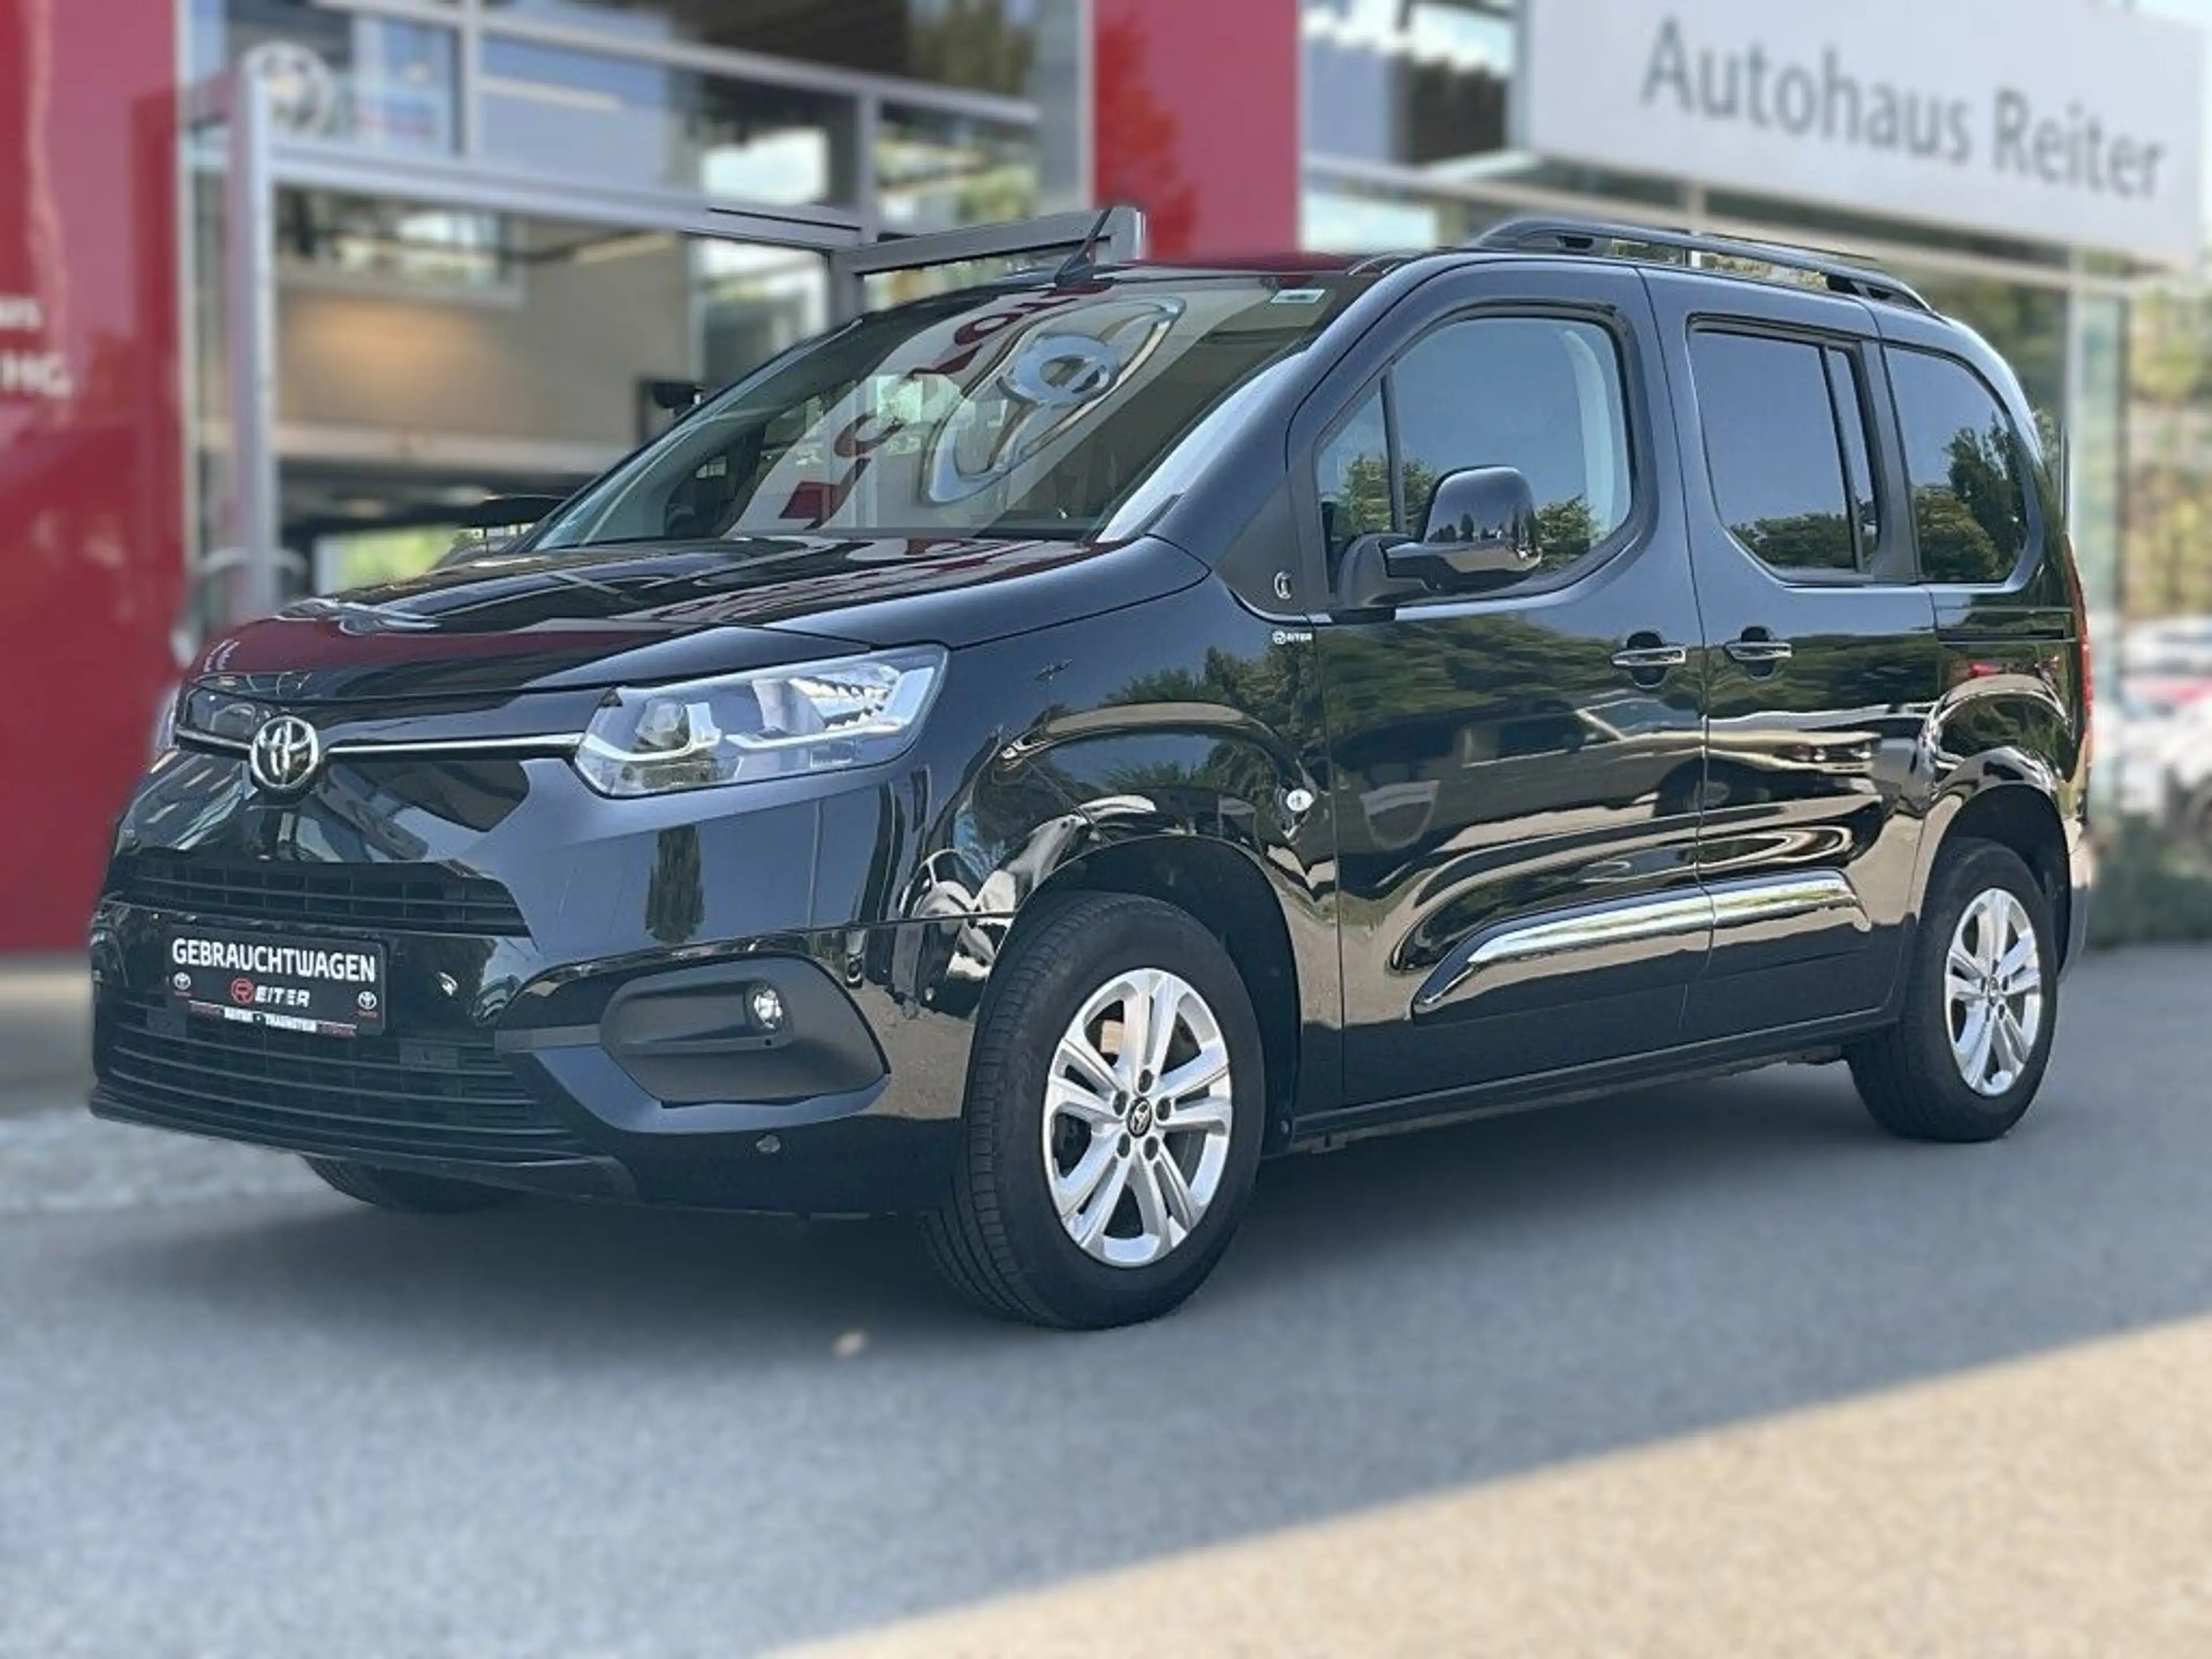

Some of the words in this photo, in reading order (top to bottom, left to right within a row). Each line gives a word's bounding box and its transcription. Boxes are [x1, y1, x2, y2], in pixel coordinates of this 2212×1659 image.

[1639, 14, 1974, 167] Autohaus
[1991, 85, 2166, 199] Reiter
[172, 937, 376, 983] GEBRAUCHTWAGEN
